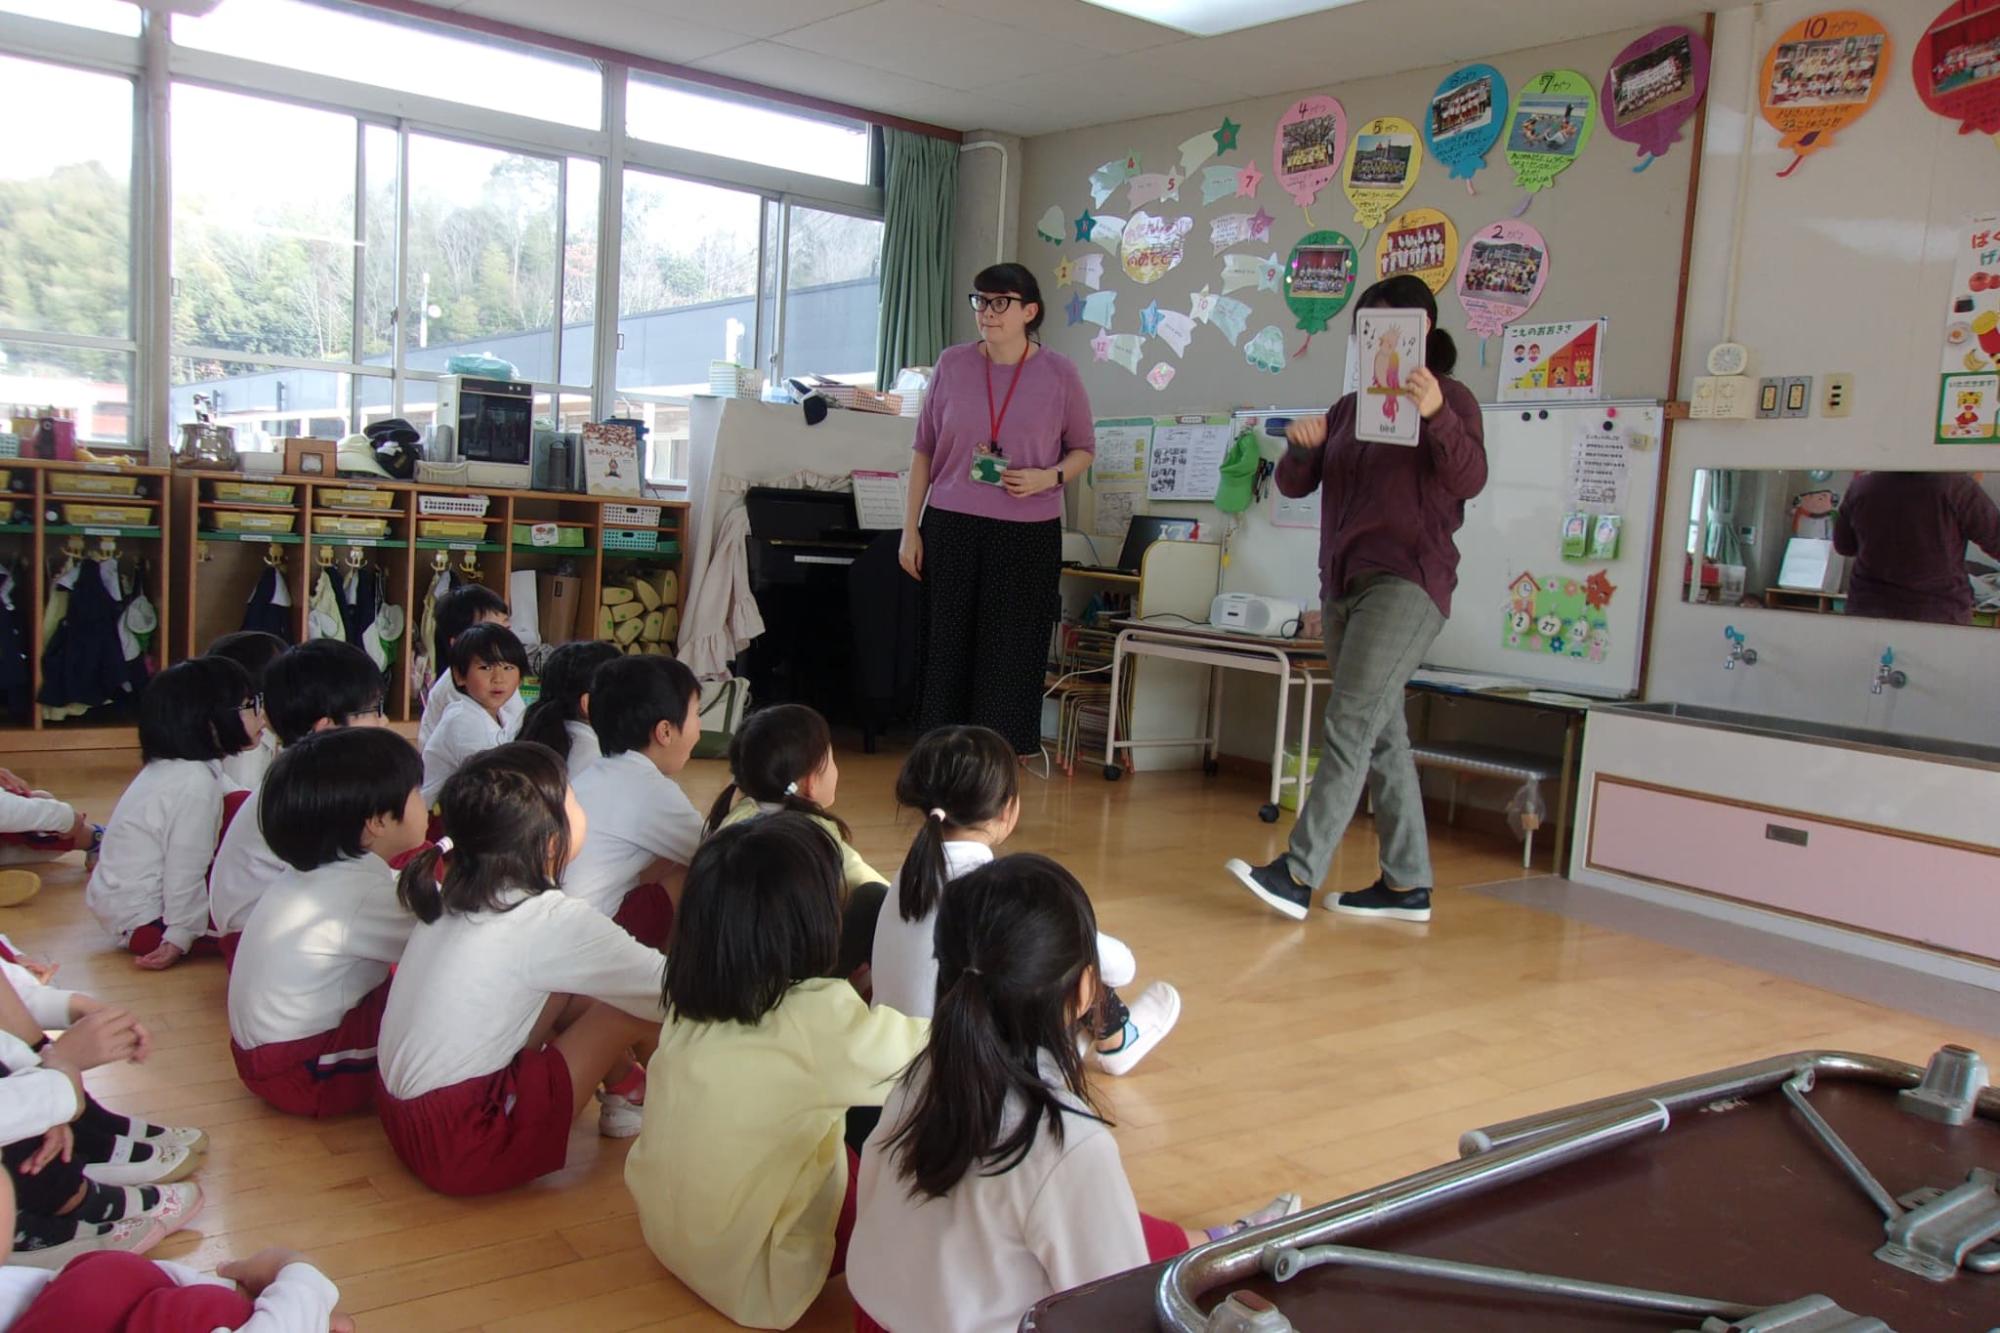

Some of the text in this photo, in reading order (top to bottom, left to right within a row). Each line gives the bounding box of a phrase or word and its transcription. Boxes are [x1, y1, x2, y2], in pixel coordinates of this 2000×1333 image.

[1167, 178, 1175, 190] 5
[1245, 175, 1254, 188] 7
[1266, 268, 1276, 281] 9
[1511, 324, 1572, 338] こえのおおきさ
[1379, 424, 1396, 433] bird
[1515, 617, 1523, 627] 2
[1542, 621, 1556, 633] 27
